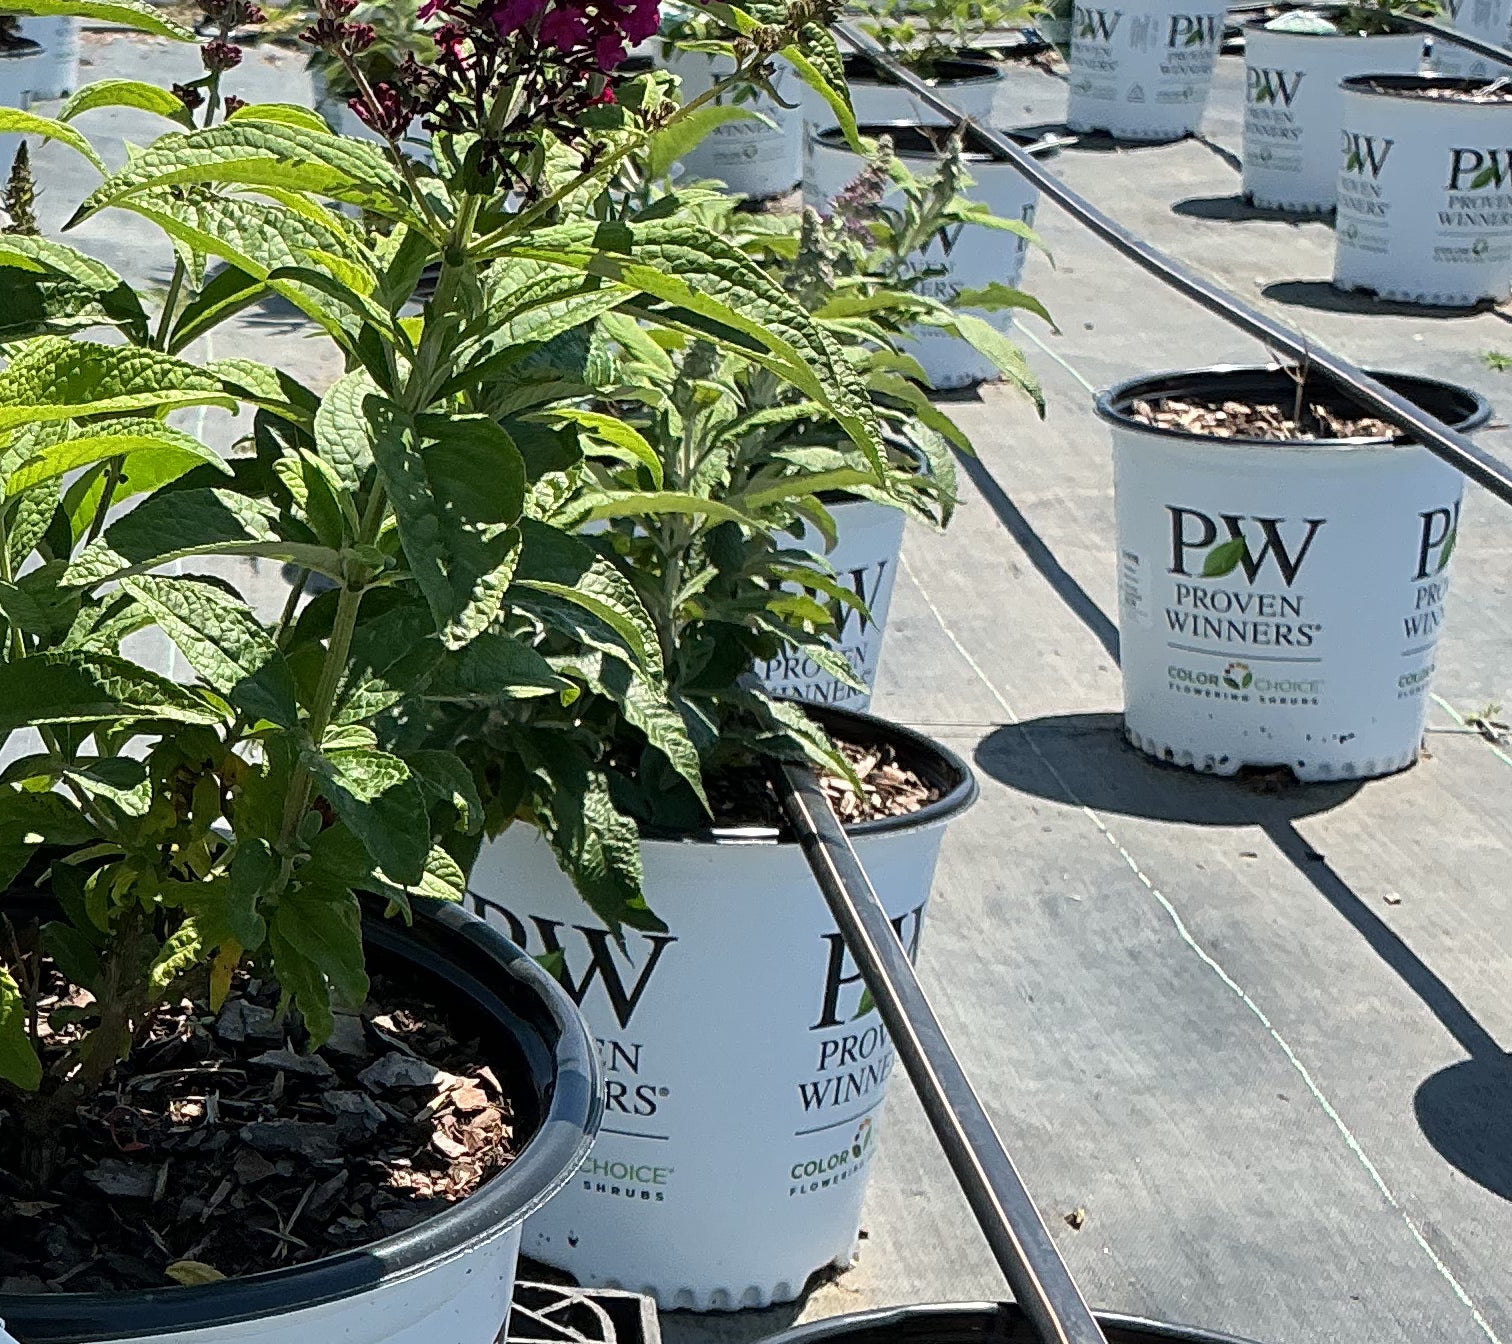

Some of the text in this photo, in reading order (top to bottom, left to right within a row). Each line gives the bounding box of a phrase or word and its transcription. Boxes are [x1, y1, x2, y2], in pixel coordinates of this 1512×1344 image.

[1164, 503, 1327, 588] PW
[1175, 583, 1304, 618] PROVEN
[1167, 664, 1220, 687] COLOR
[790, 1147, 850, 1181] COLOR
